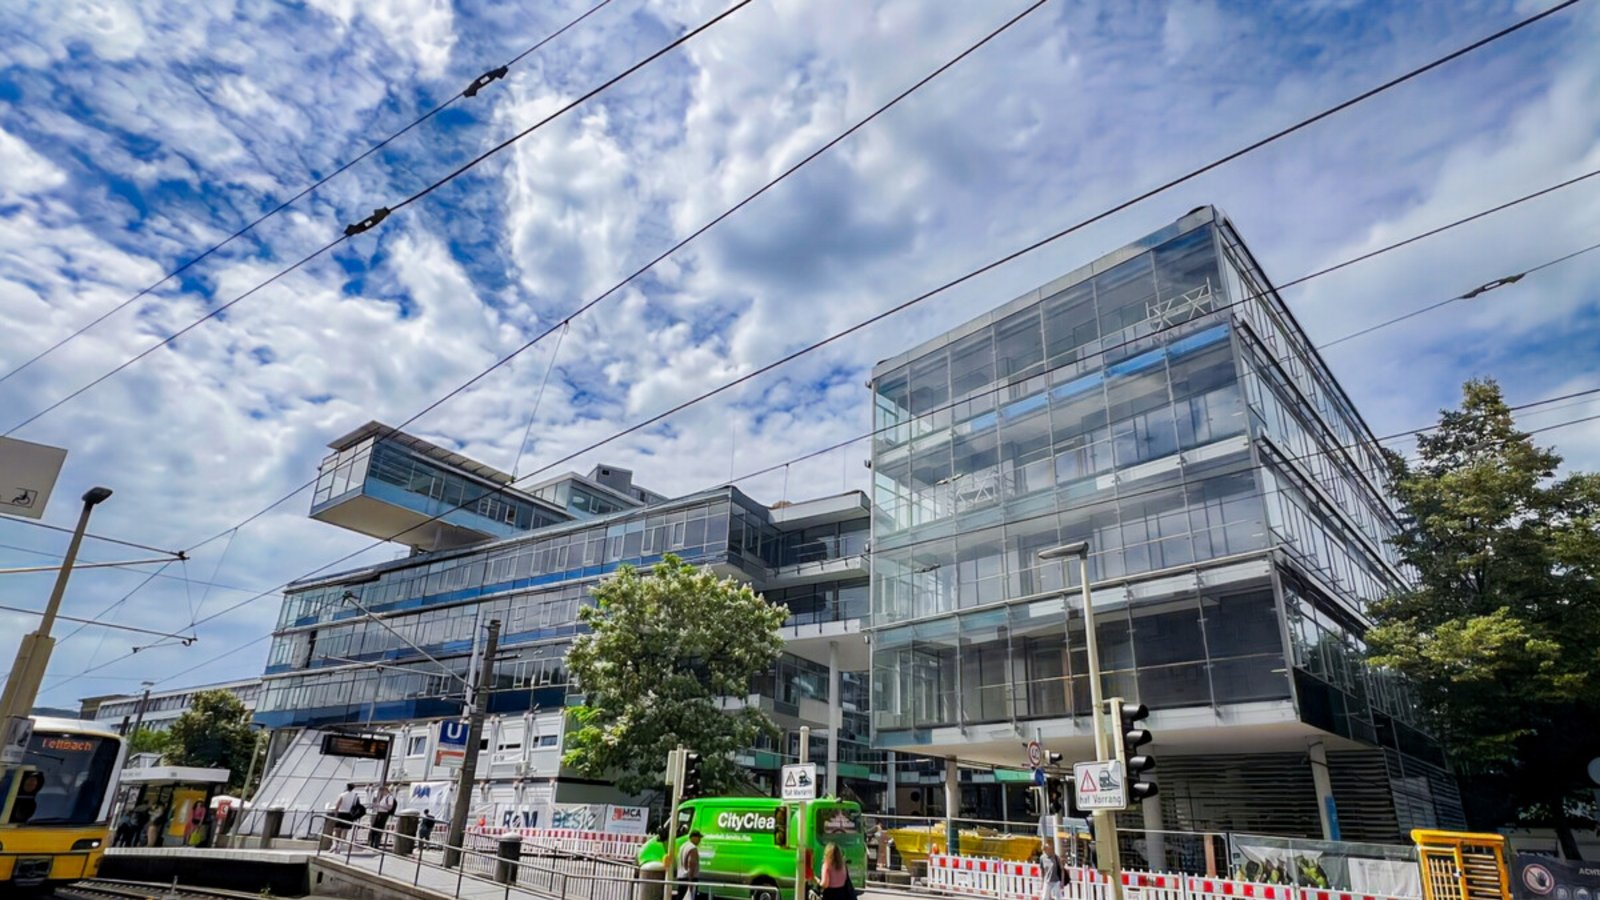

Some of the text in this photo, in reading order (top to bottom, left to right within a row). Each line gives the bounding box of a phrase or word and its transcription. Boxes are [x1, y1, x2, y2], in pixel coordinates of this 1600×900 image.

[447, 722, 462, 739] U
[1094, 793, 1122, 806] Vorrang
[623, 808, 642, 818] MCA
[717, 812, 776, 831] CityClea
